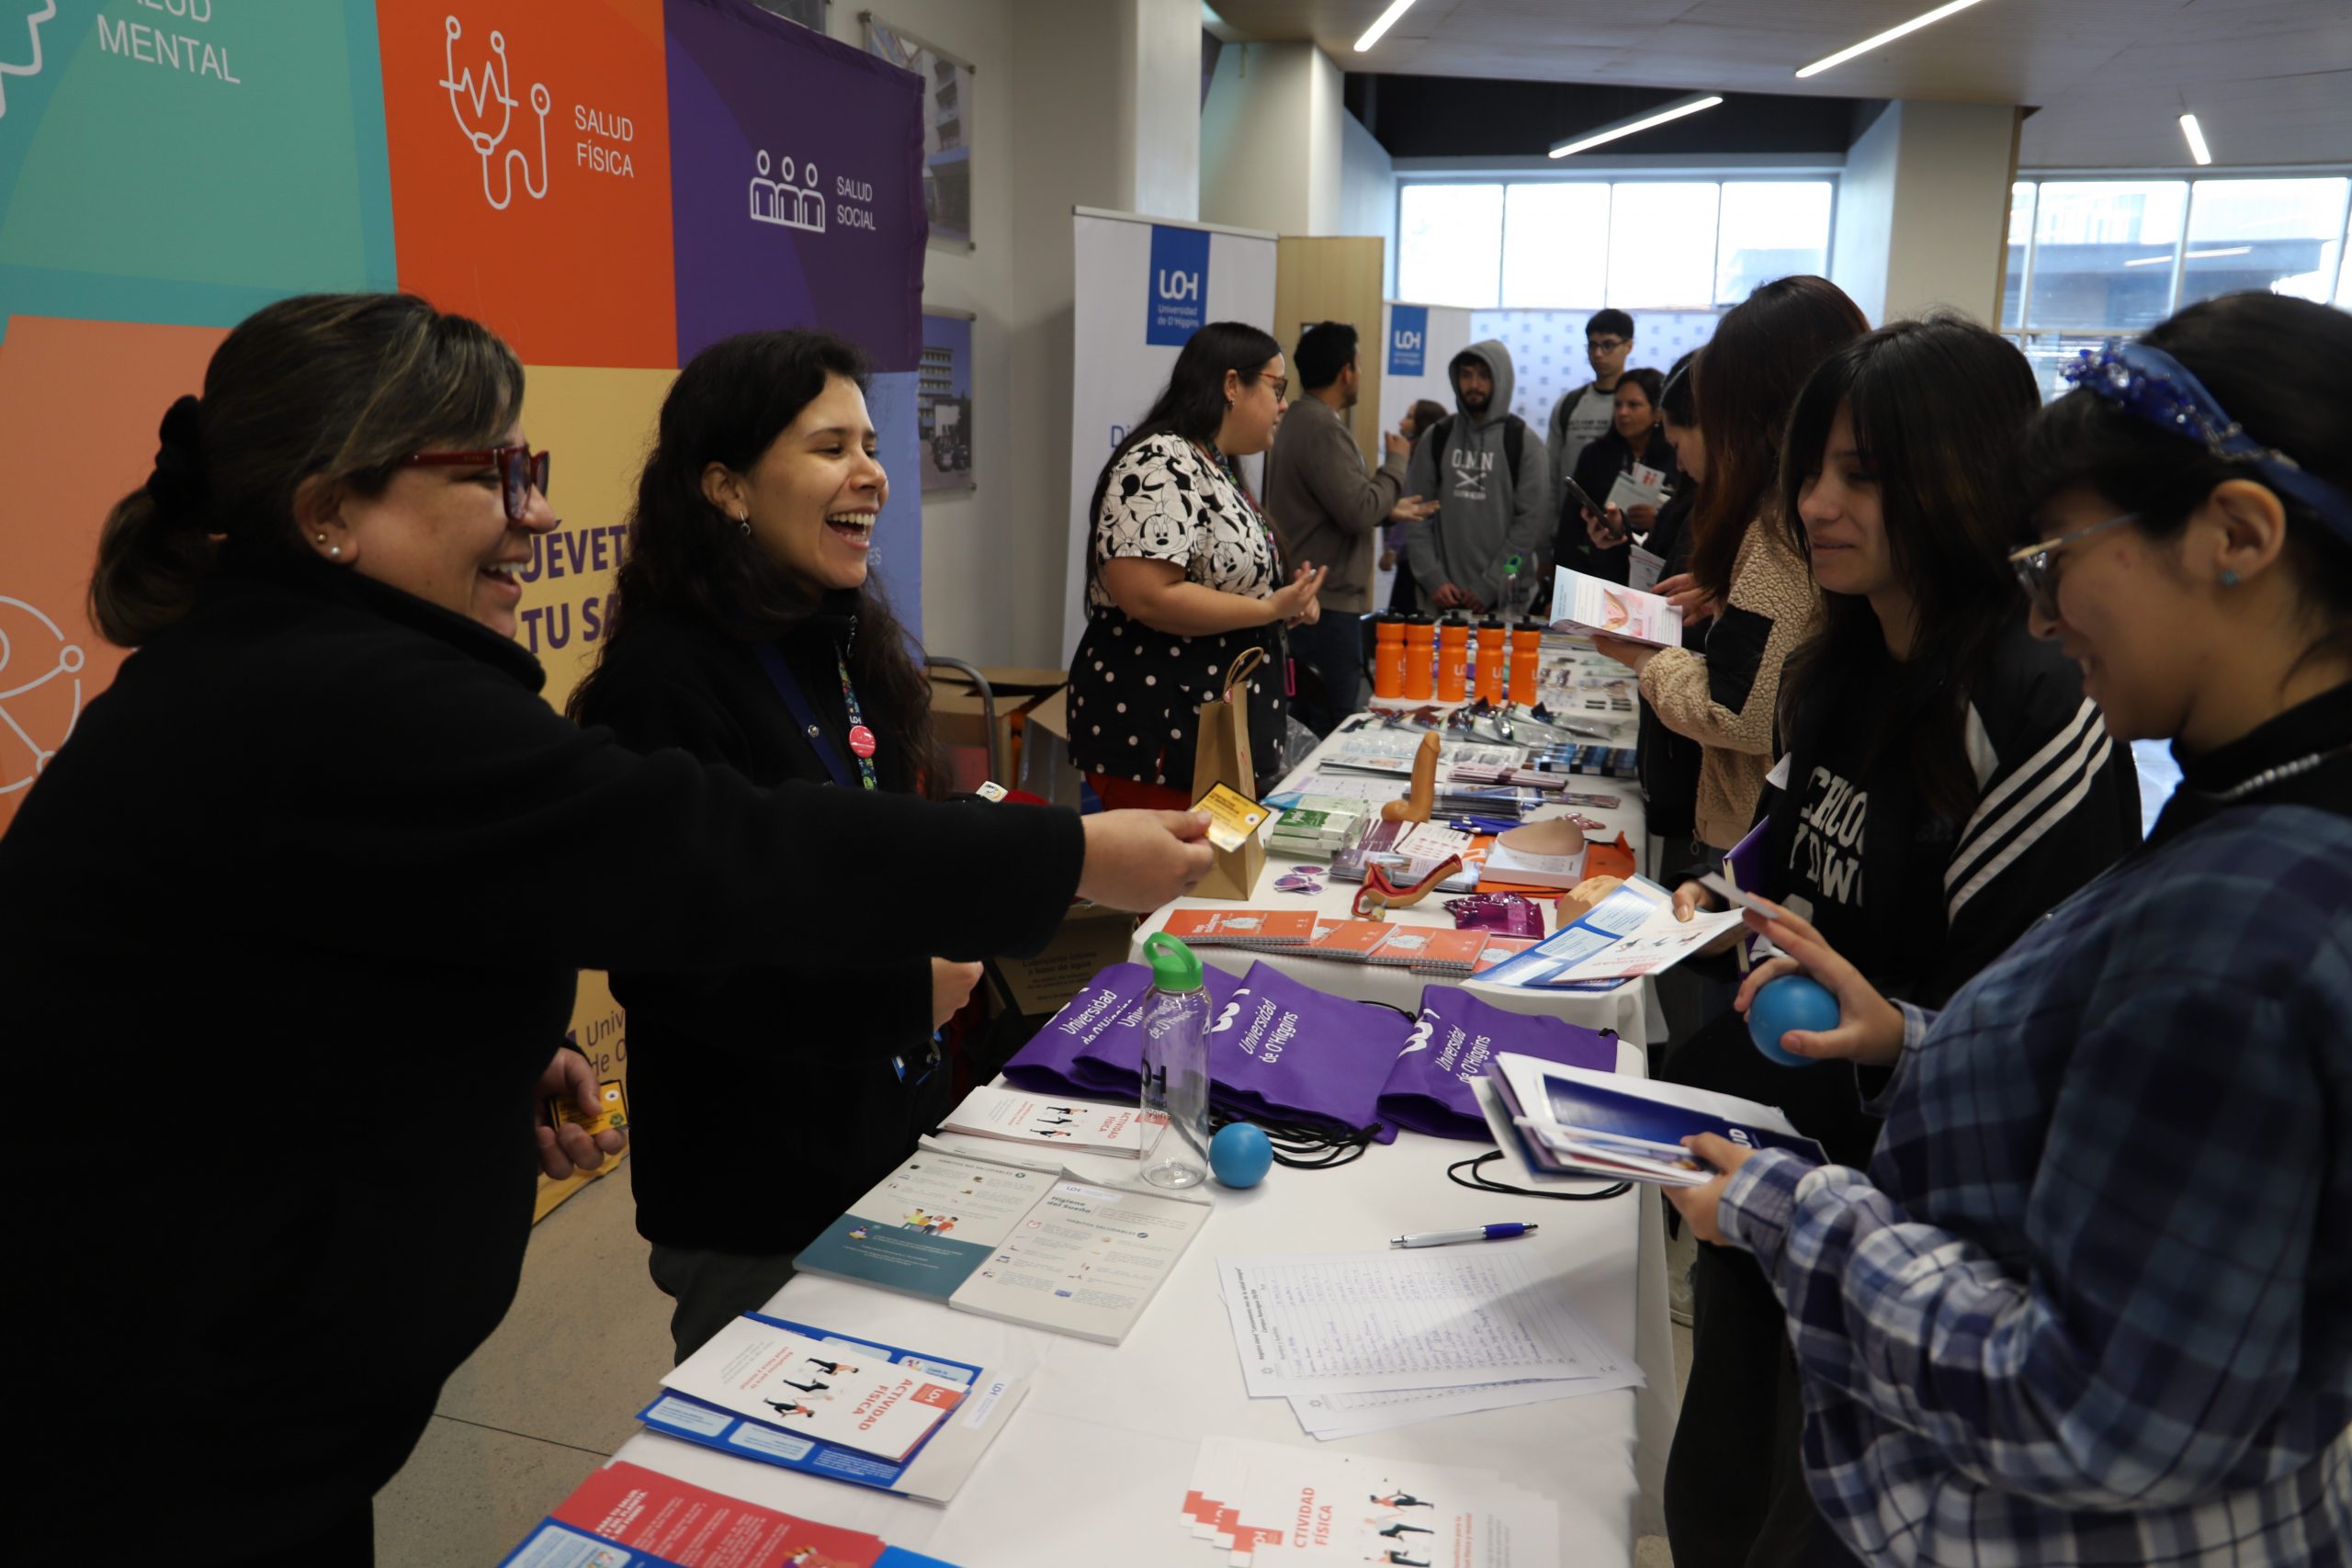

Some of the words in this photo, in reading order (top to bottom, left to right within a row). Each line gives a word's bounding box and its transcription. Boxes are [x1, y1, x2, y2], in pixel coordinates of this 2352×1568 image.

[97, 14, 241, 84] MENTAL
[575, 105, 633, 141] SALUD
[577, 139, 634, 178] FÍSICA
[837, 175, 873, 202] SALUD
[837, 204, 876, 231] SOCIAL
[521, 603, 571, 654] TU
[1058, 988, 1117, 1035] Universidad
[1238, 997, 1277, 1055] Universidad
[1264, 1011, 1298, 1053] O'Higgins
[1259, 1052, 1279, 1064] de
[1434, 1023, 1466, 1072] Universidad
[1460, 1034, 1491, 1074] O'Higgins
[1051, 1196, 1086, 1207] Higiene
[1062, 1202, 1091, 1213] Sueño
[858, 1379, 914, 1431] ACTIVIDAD
[1294, 1487, 1315, 1548] CTIVIDAD
[1313, 1505, 1332, 1546] FÍSICA
